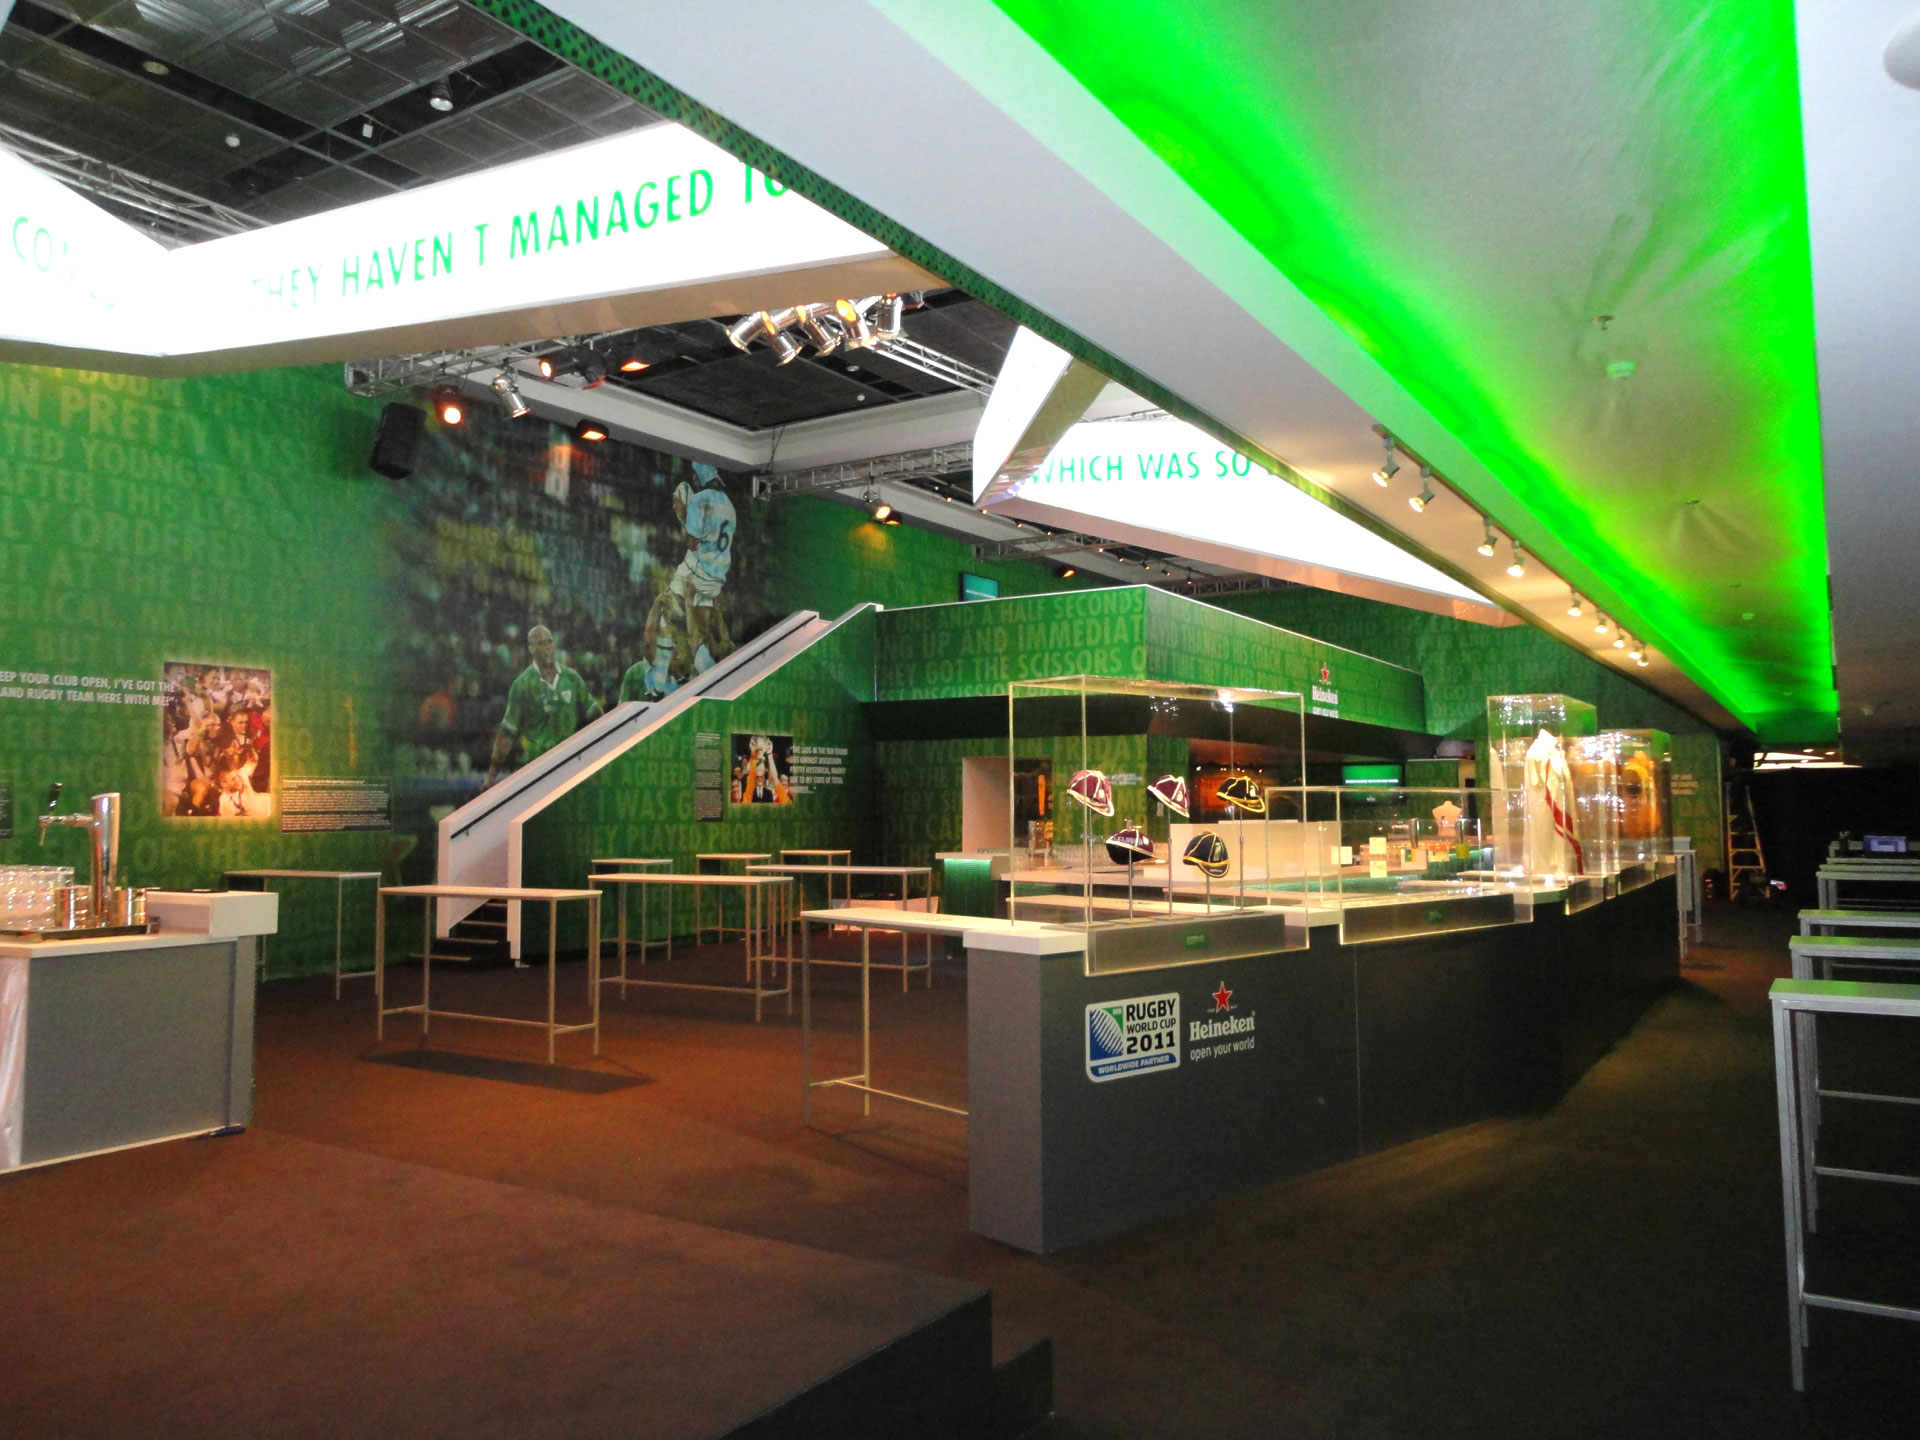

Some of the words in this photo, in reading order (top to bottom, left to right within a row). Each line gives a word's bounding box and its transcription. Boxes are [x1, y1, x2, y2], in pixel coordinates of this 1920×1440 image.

[509, 168, 714, 260] MANAGED
[1031, 455, 1124, 485] WHICH
[1138, 451, 1200, 481] WAS
[1216, 450, 1252, 478] SO
[717, 519, 730, 553] 6
[1054, 588, 1144, 619] SECONDS
[962, 625, 1009, 656] AND
[972, 655, 1010, 682] THE
[1018, 647, 1123, 680] SCISSORS
[19, 672, 50, 685] YOUR
[53, 674, 79, 686] CLUB
[81, 676, 111, 689] OPEN,
[114, 678, 134, 690] I'VE
[136, 680, 156, 692] GOT
[158, 681, 177, 693] THE
[27, 688, 64, 700] RUGBY
[67, 690, 94, 702] TEAM
[97, 692, 122, 704] HERE
[125, 694, 150, 705] WITH
[1126, 998, 1176, 1022] RUGBY
[1127, 1021, 1158, 1034] WORLD
[1160, 1017, 1177, 1029] CUP
[1190, 1014, 1255, 1042] Heineken
[1126, 1030, 1175, 1055] 2011
[1190, 1046, 1212, 1061] open
[1213, 1042, 1232, 1058] your
[1233, 1036, 1255, 1051] world
[1098, 1060, 1140, 1075] WORLDWIDE
[1140, 1055, 1170, 1067] PARTNER
